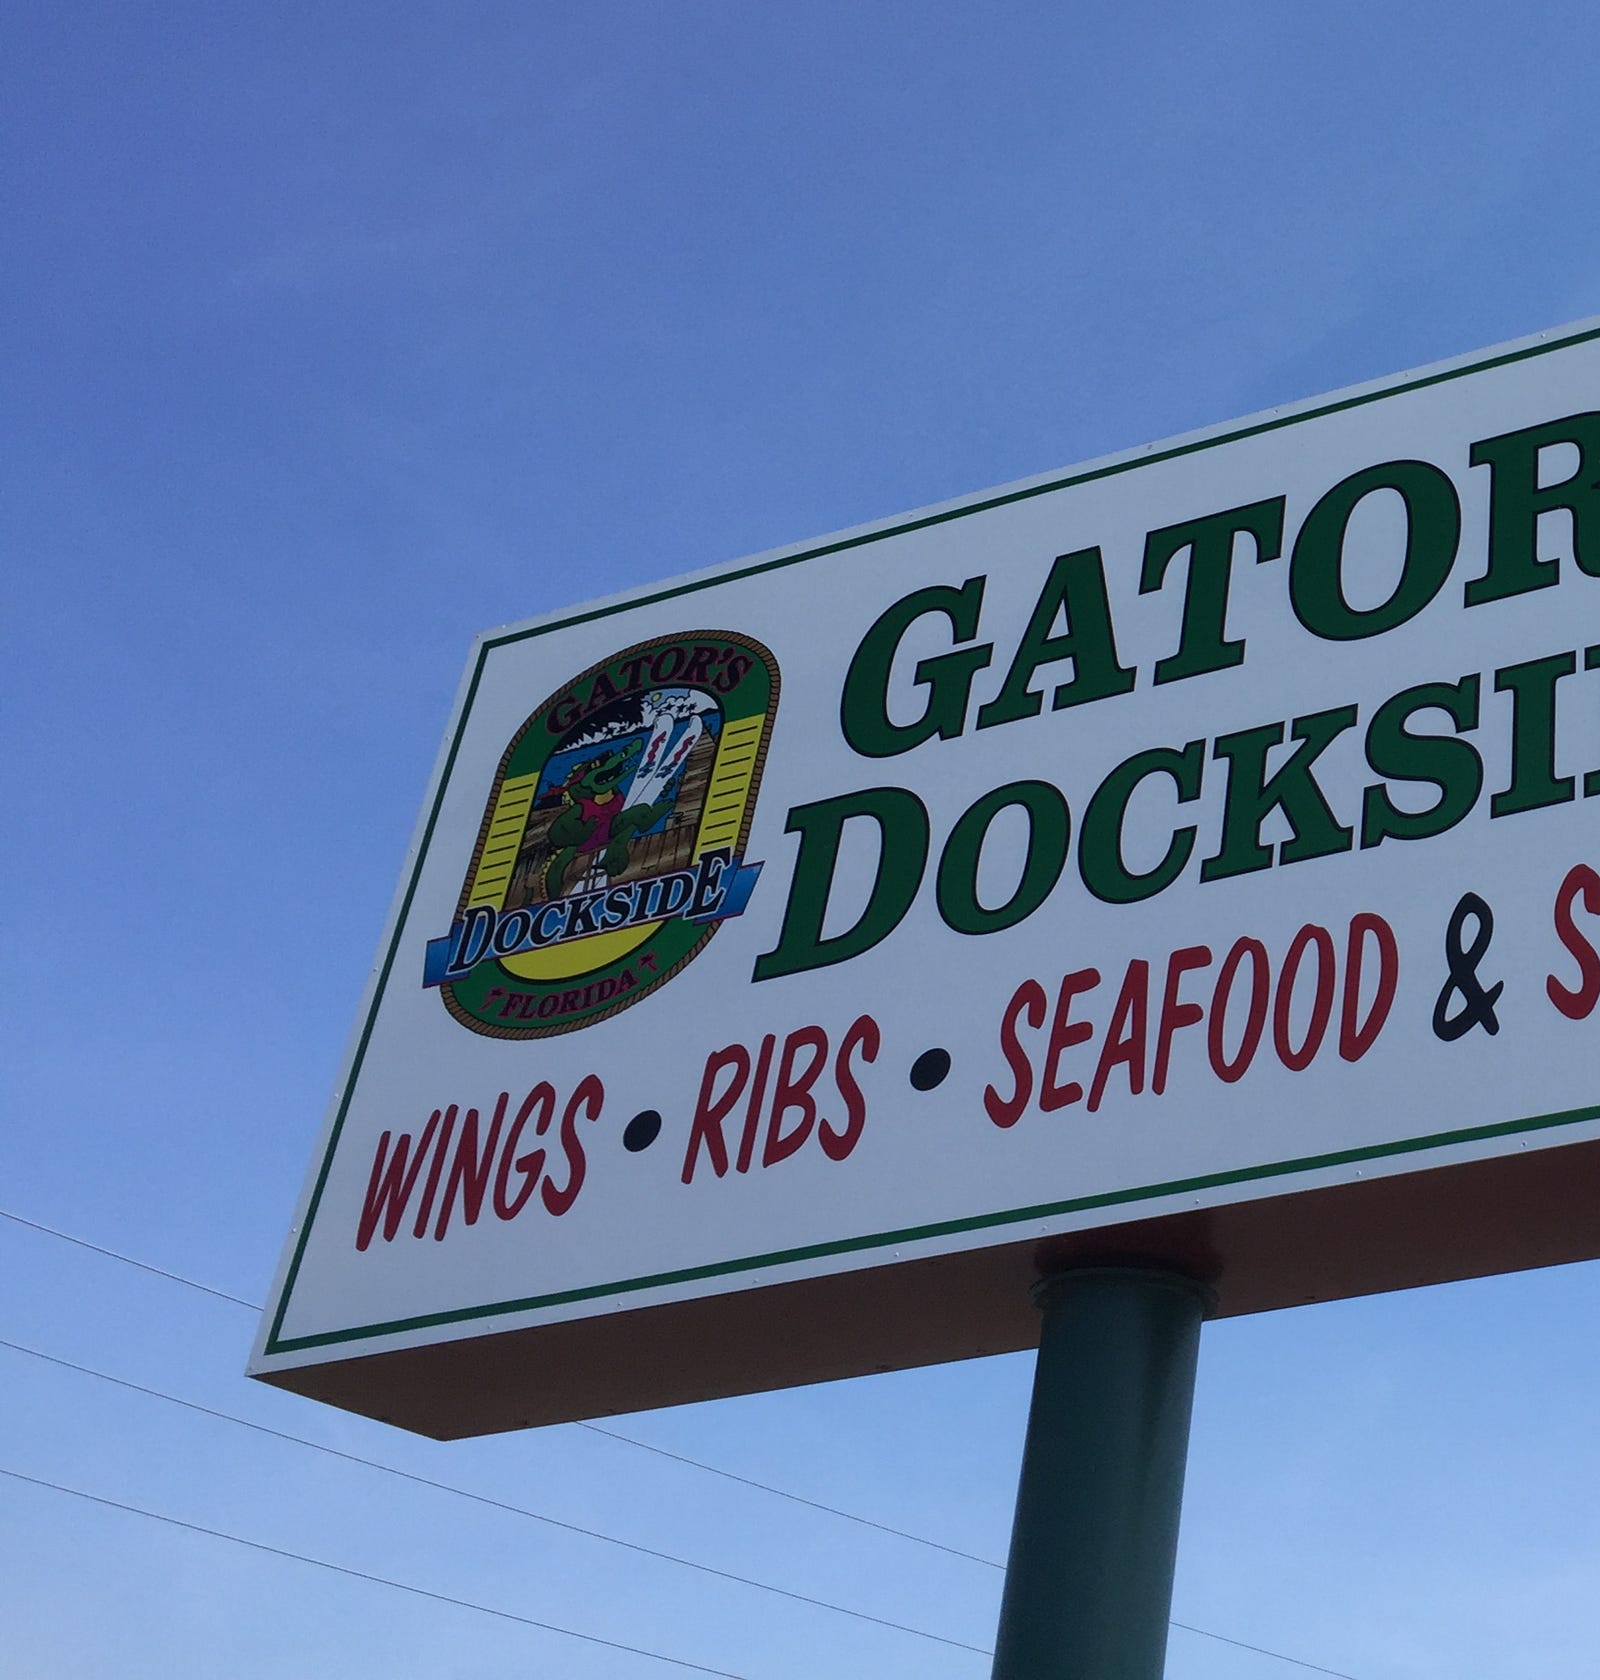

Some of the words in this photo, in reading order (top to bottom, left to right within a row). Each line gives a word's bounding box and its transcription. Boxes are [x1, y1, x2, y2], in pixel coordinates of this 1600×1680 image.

[546, 645, 754, 736] GATOR'S
[446, 846, 731, 975] DOCKSIDE
[497, 967, 638, 1020] FLORIDA
[355, 1074, 604, 1251] WINGS
[681, 1014, 880, 1184] RIBS
[984, 912, 1398, 1128] SEAFOOD
[1432, 892, 1504, 1041] &
